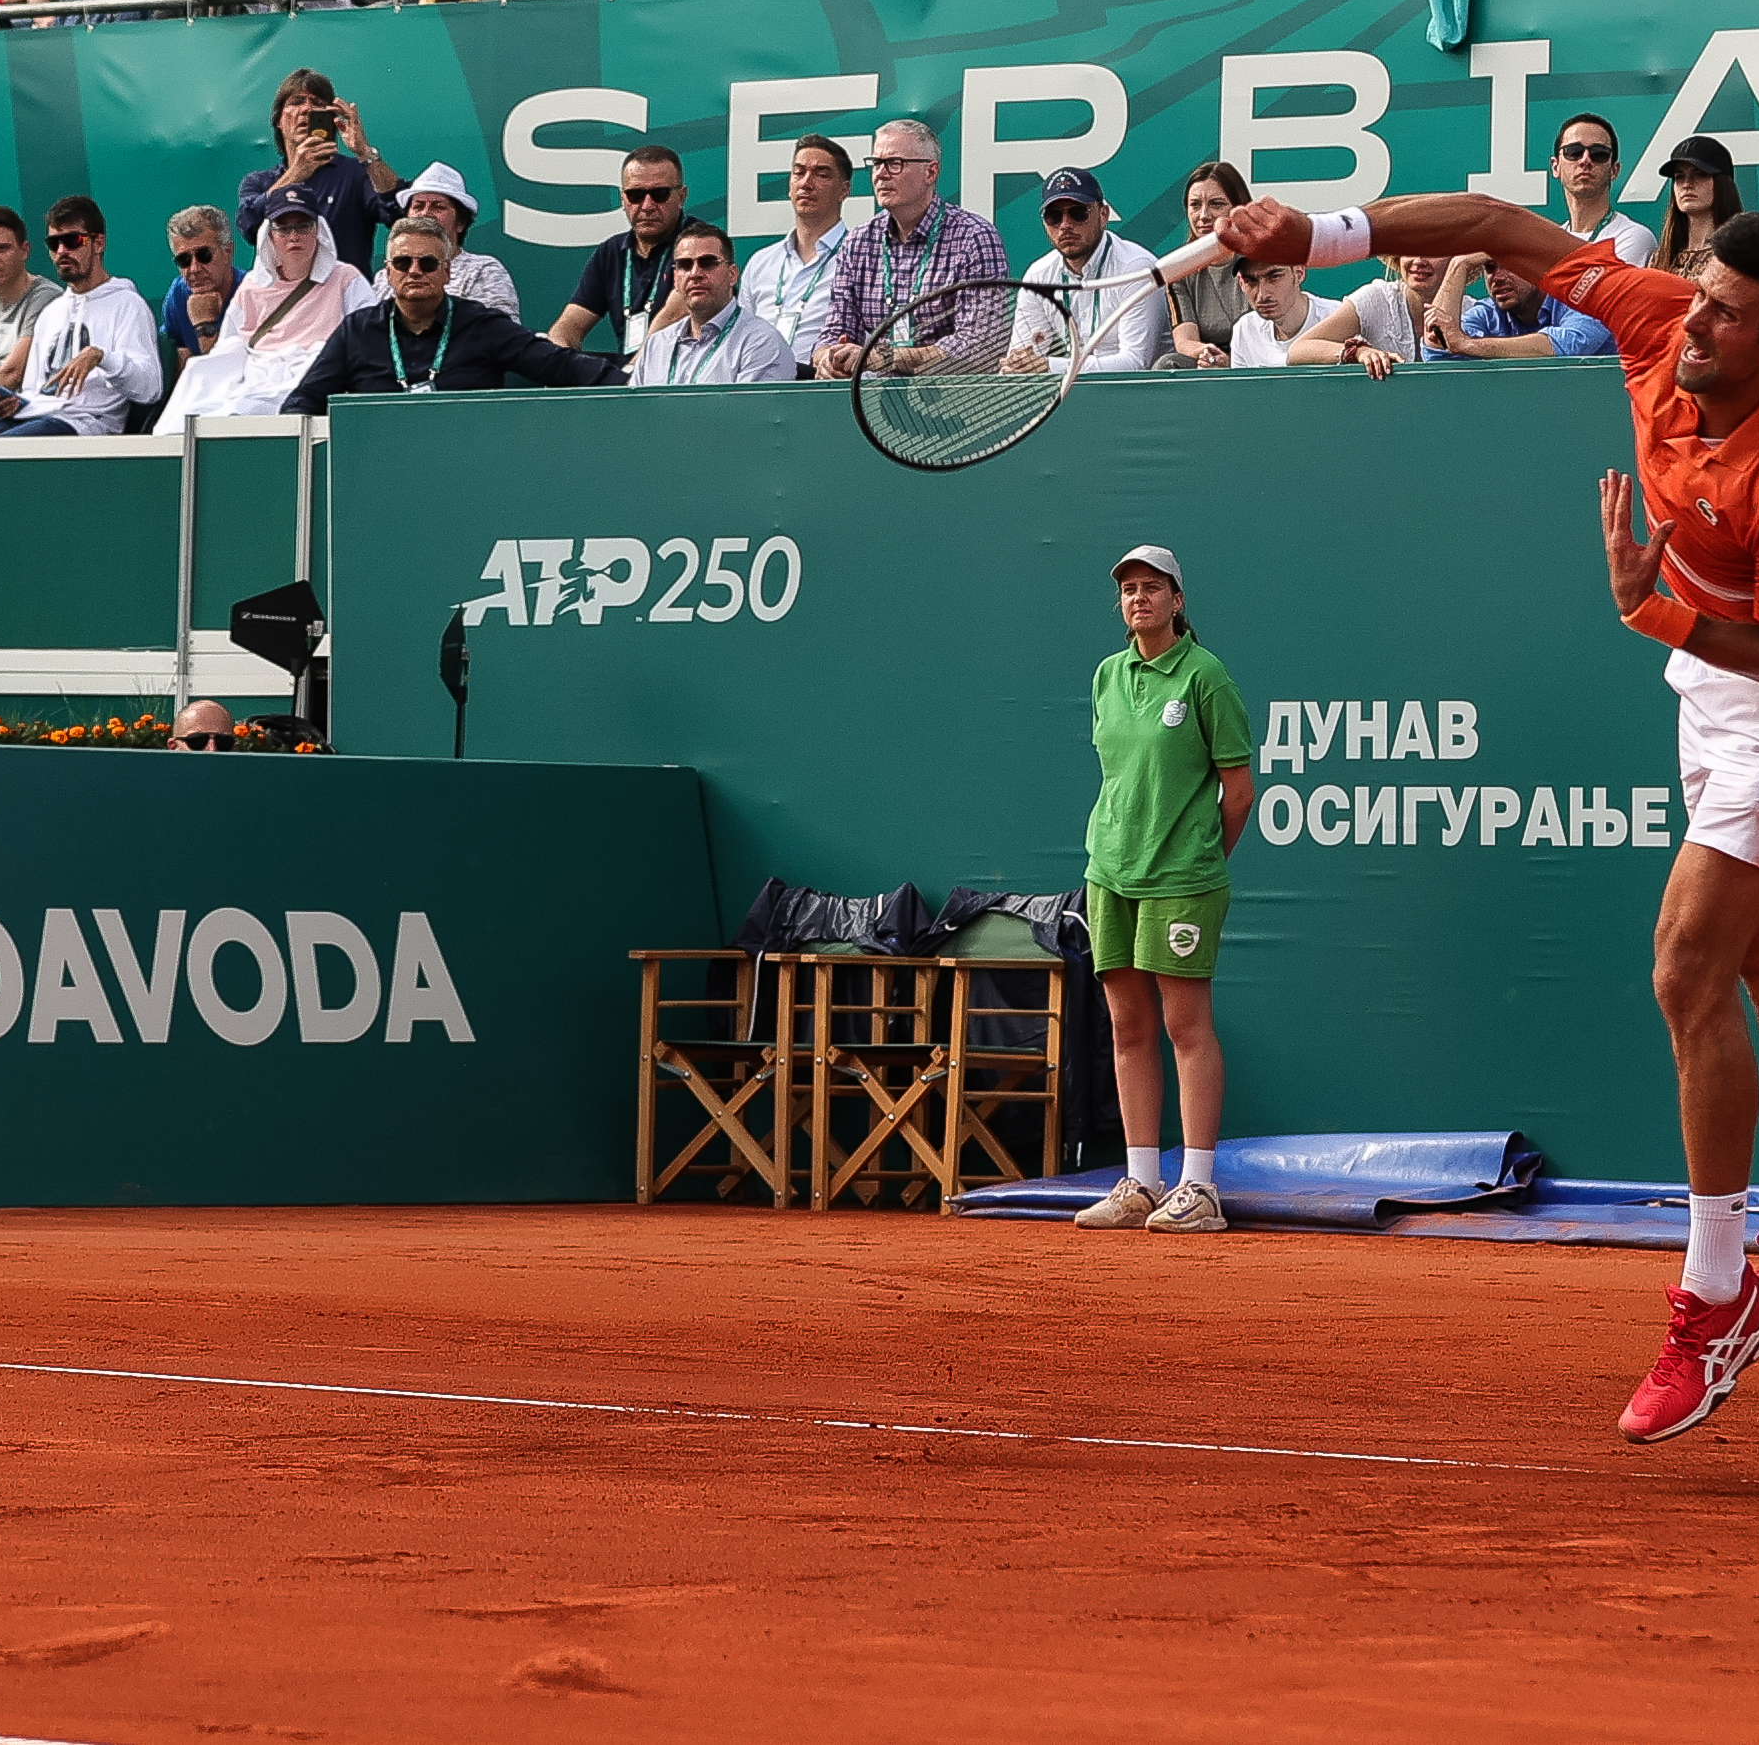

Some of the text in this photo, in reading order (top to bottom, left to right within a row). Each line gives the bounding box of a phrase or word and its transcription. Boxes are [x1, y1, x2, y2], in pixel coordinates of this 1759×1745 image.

[451, 535, 803, 627] ATP 250
[1258, 699, 1480, 775] ДУНАВ
[1257, 783, 1673, 848] ОСИГУРАЊЕ
